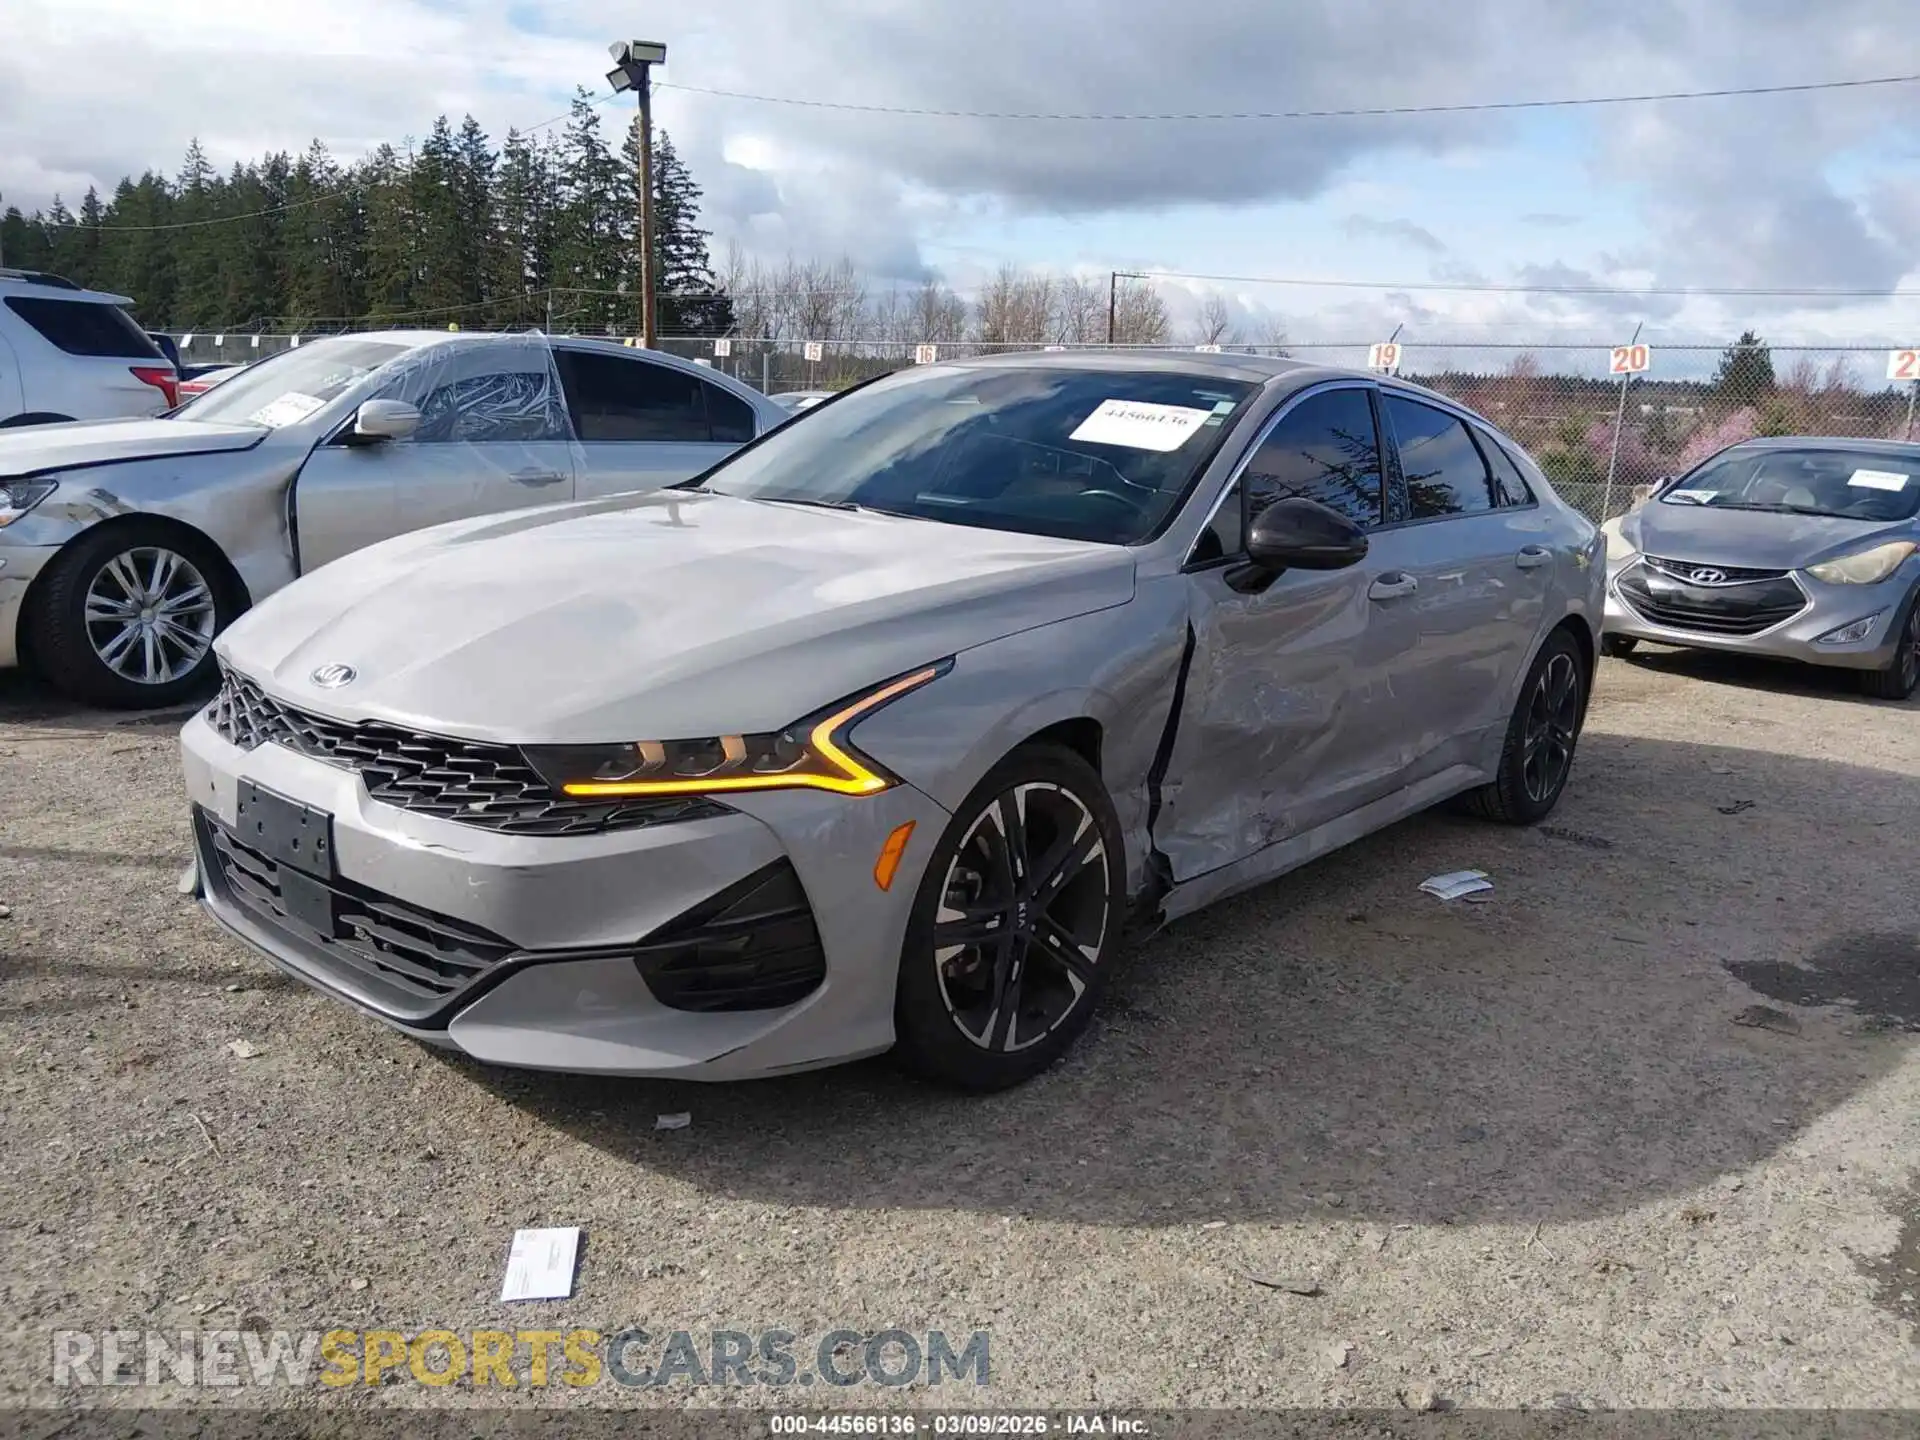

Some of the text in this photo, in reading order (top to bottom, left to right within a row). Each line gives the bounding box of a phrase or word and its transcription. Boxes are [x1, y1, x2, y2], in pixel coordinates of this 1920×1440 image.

[808, 344, 819, 359] 15
[920, 346, 933, 362] 16
[1375, 344, 1396, 366] 19
[1614, 346, 1646, 372] 20
[1896, 351, 1920, 377] 2
[1018, 901, 1027, 929] KIA
